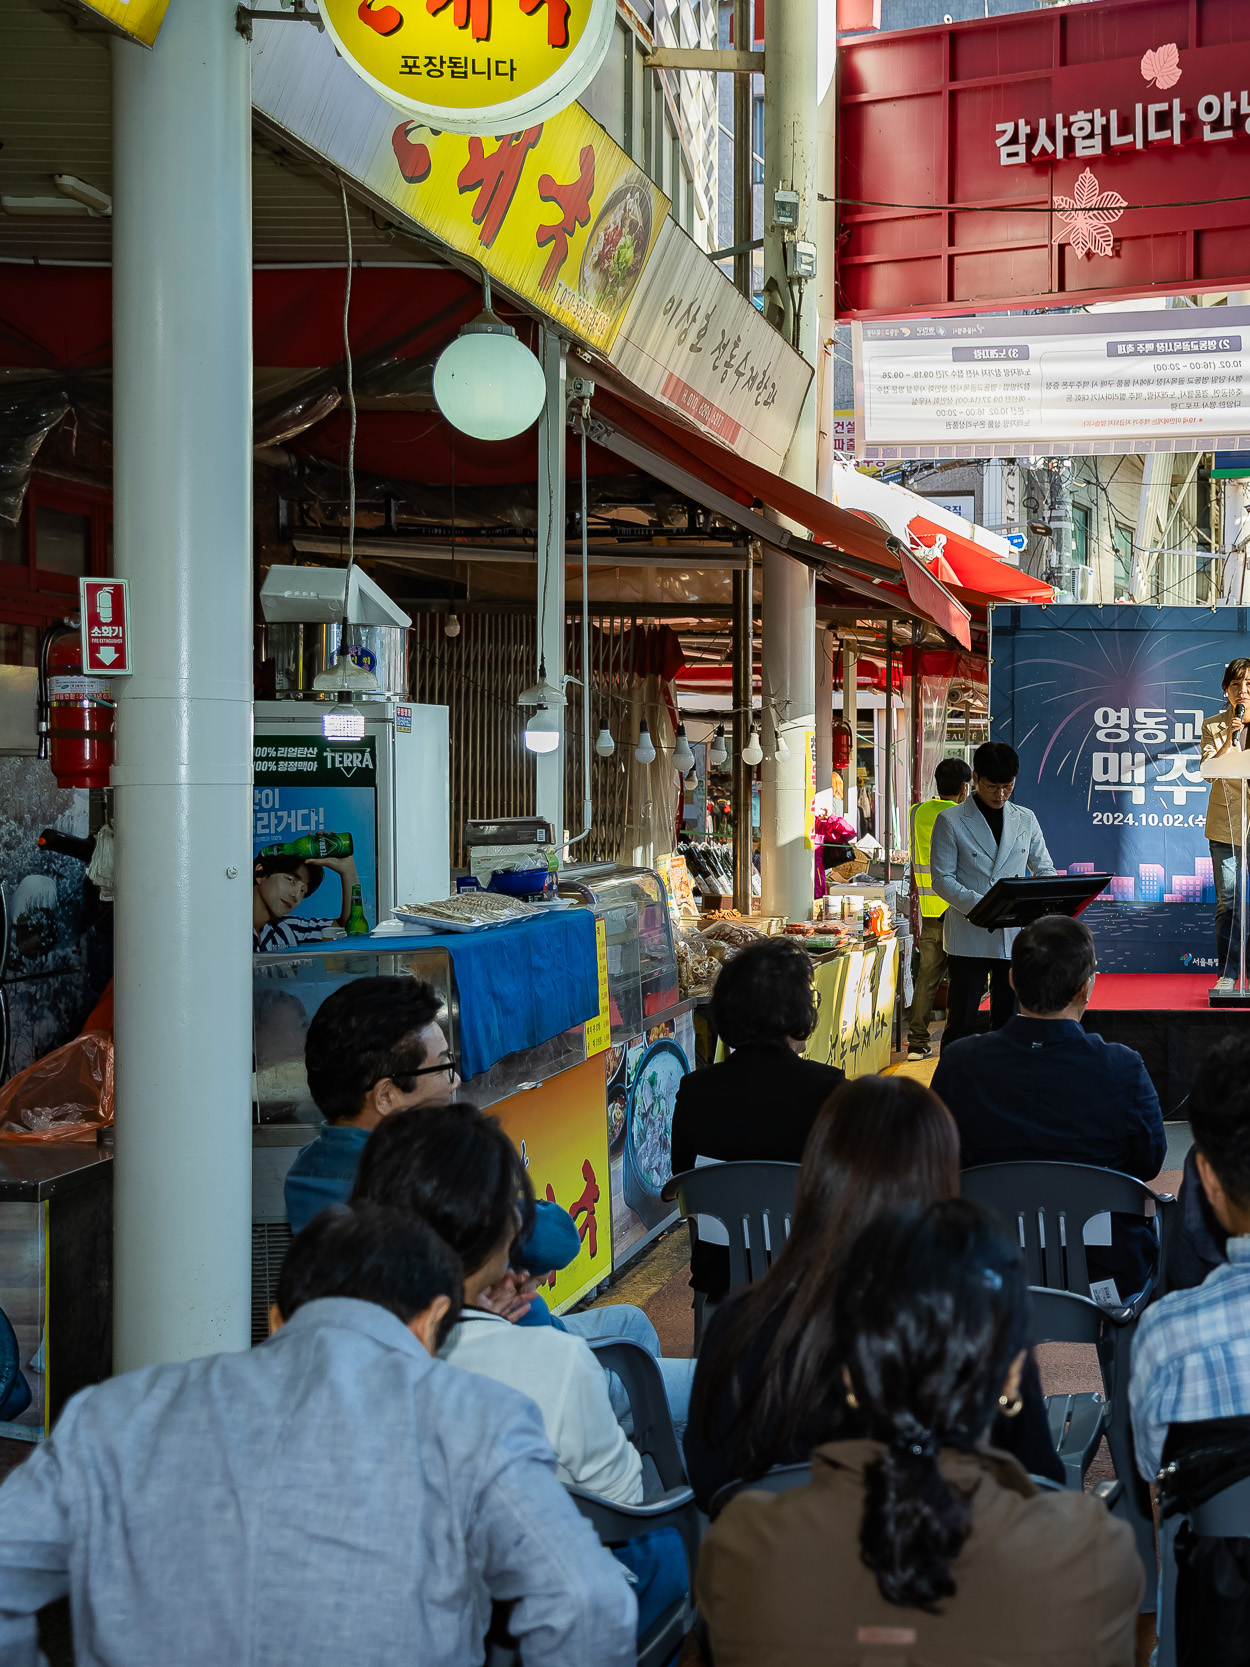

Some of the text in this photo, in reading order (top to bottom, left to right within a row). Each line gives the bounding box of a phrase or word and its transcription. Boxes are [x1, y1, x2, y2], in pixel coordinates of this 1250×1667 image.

[399, 55, 517, 82] 포장됩니다
[995, 98, 1187, 166] 감사합니다
[662, 294, 779, 410] 이상호 전통수제한과
[91, 626, 123, 638] 소화기
[1094, 707, 1204, 744] 영동교
[277, 747, 318, 758] 리얼탄산
[323, 748, 374, 769] TERRA
[278, 761, 318, 772] 청정맥아
[1092, 752, 1207, 805] 맥주
[253, 807, 325, 834] 라거다!
